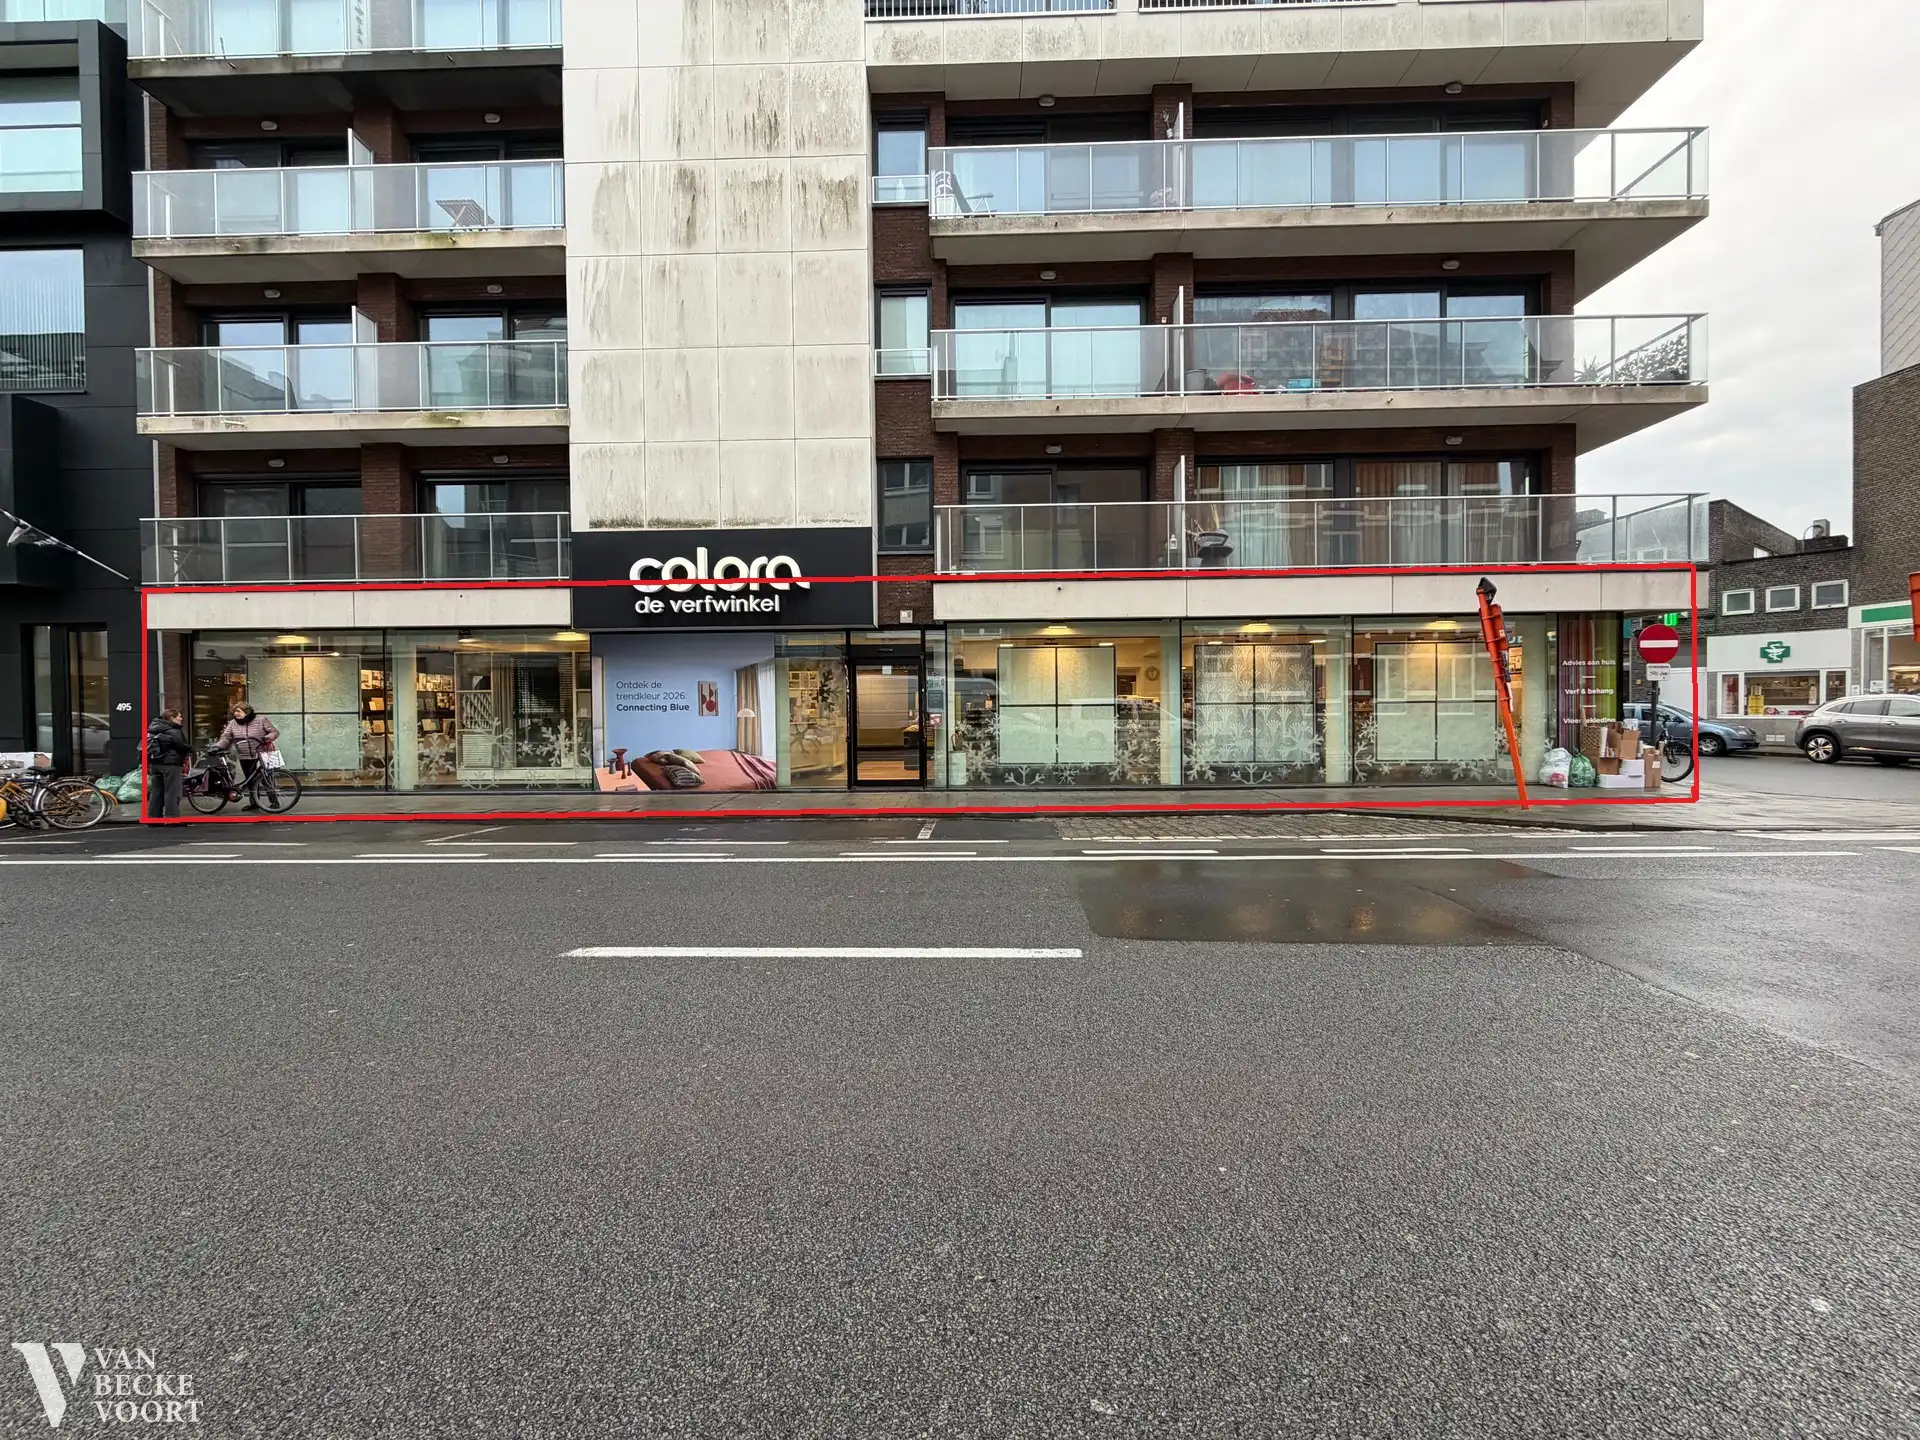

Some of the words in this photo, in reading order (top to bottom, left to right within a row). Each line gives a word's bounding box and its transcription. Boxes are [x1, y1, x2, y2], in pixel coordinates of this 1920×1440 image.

[629, 546, 811, 593] colora
[635, 596, 665, 614] de
[670, 594, 780, 613] verfwinkel
[616, 681, 649, 690] Ontdek
[650, 681, 662, 689] de
[616, 692, 661, 701] trendkleur
[662, 691, 688, 701] 2026:
[116, 702, 132, 712] 495
[616, 703, 668, 713] Connecting
[670, 703, 690, 712] Blue
